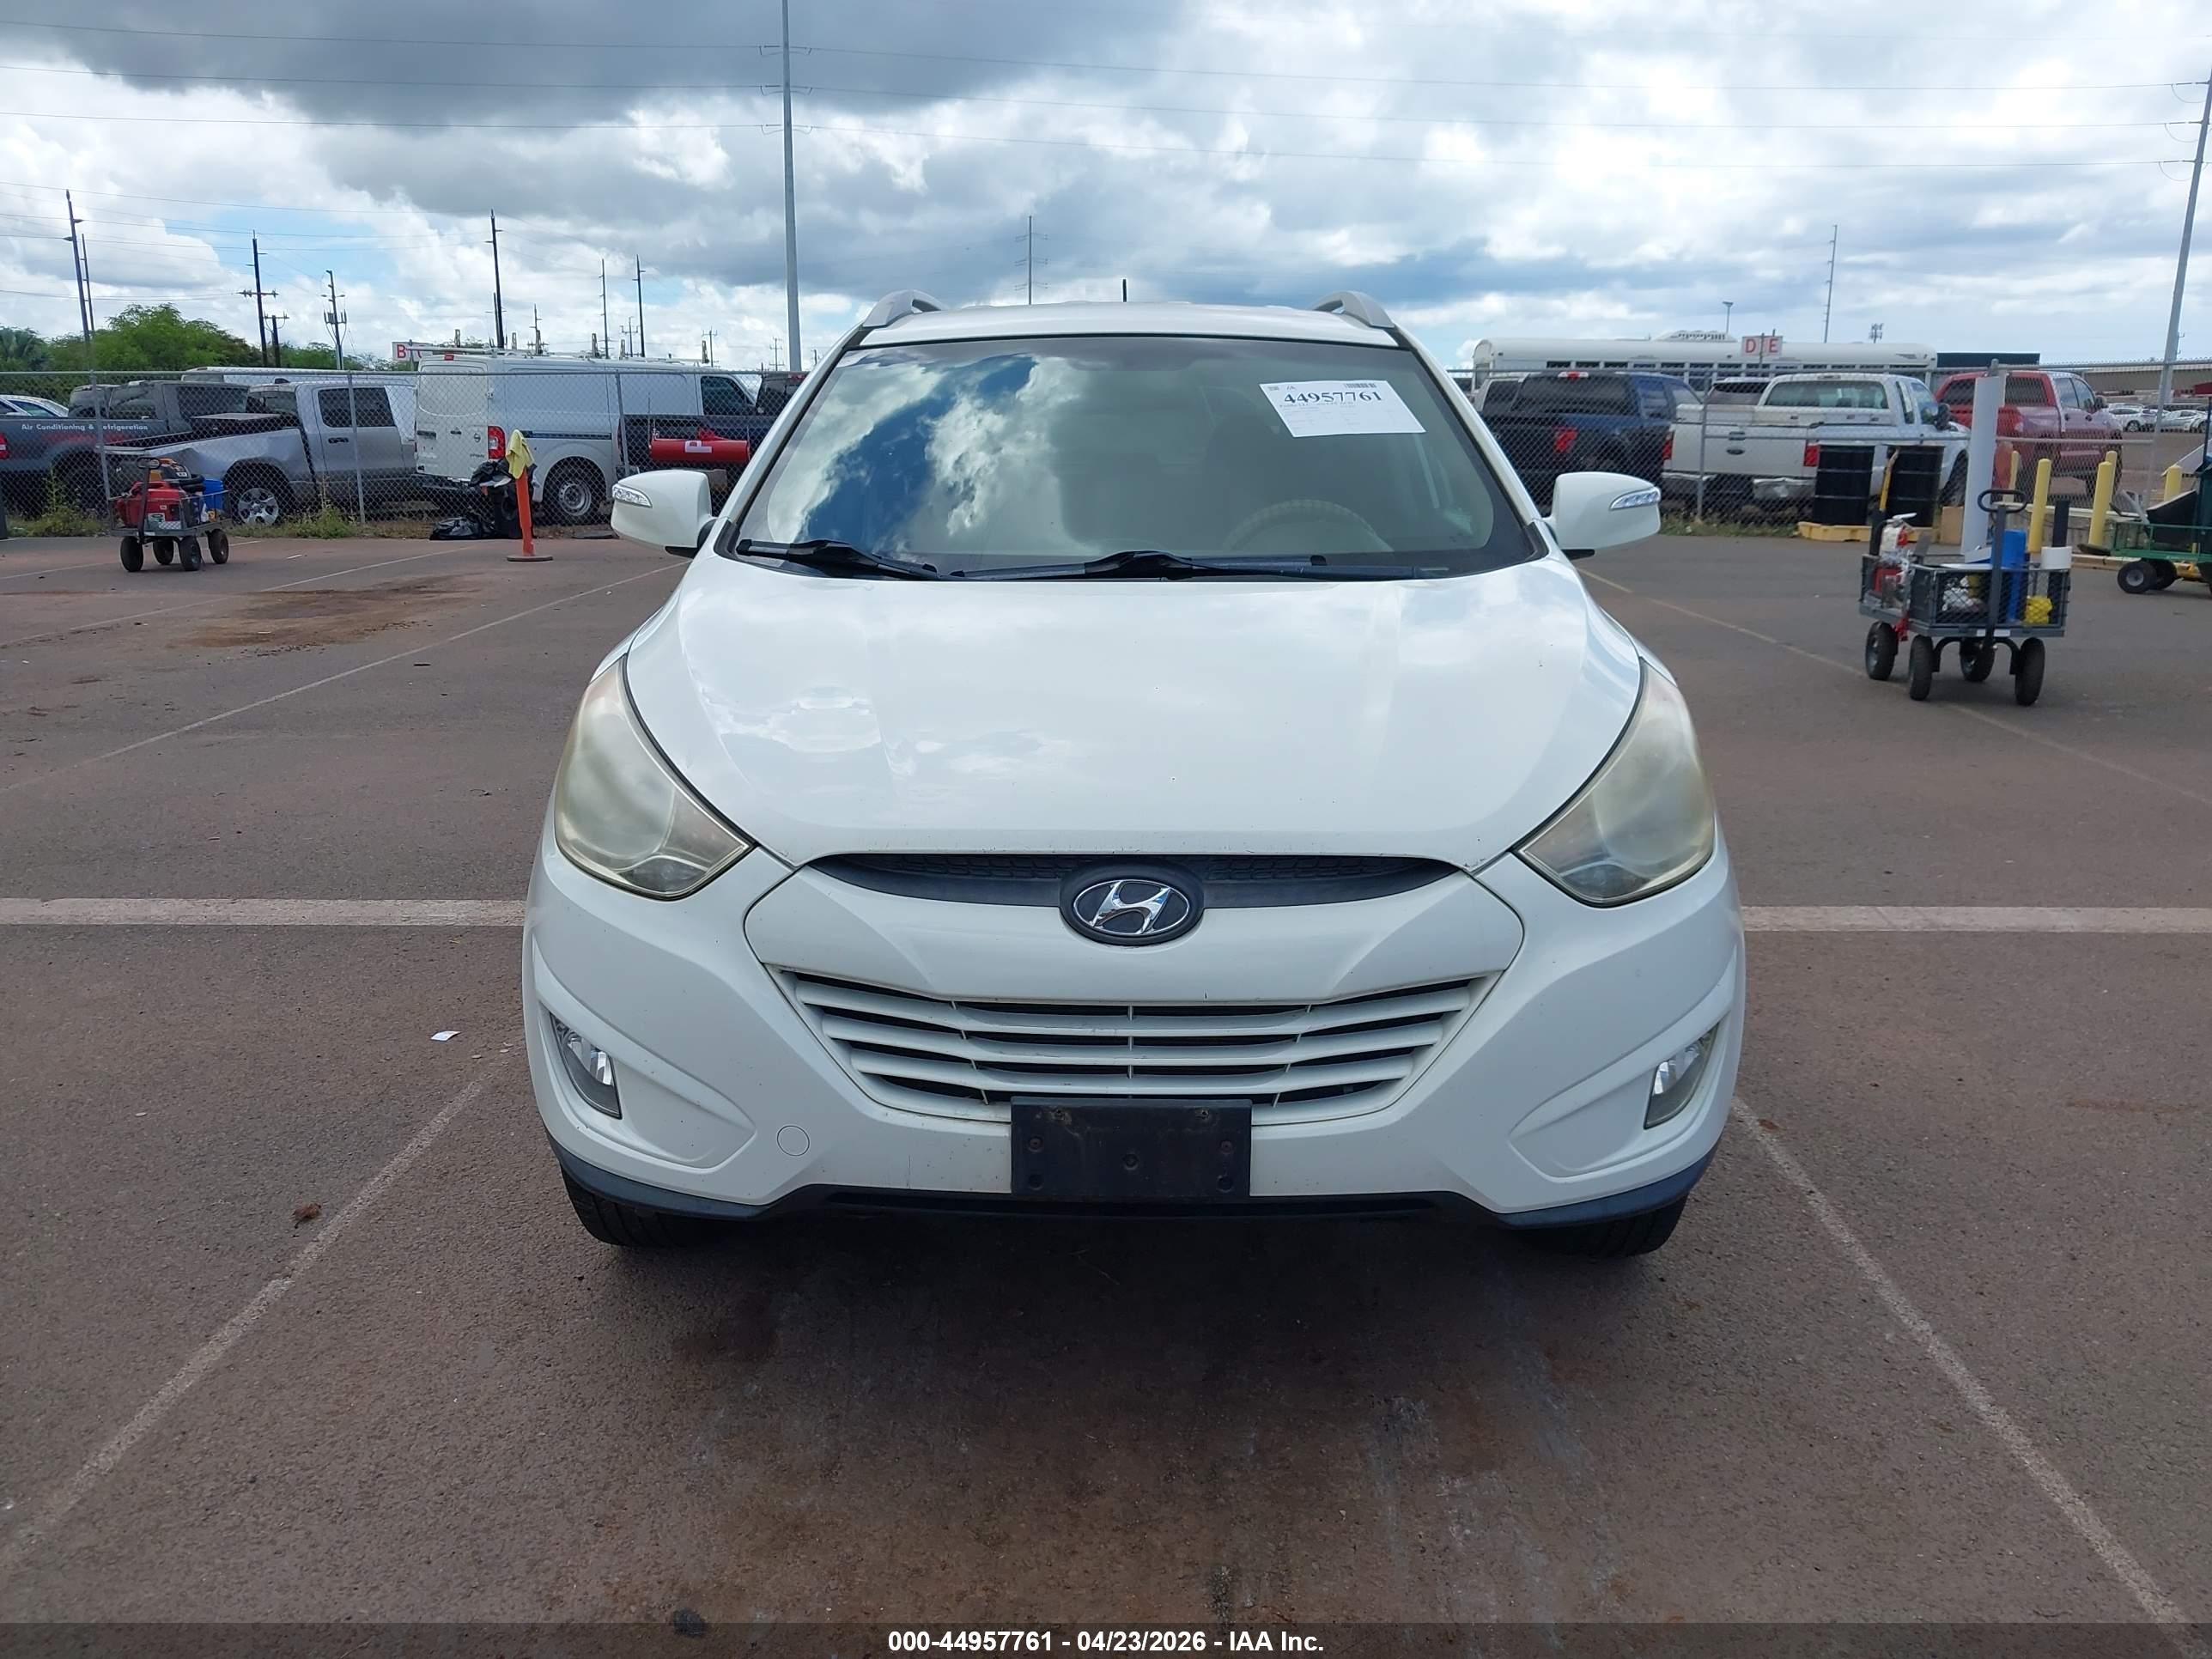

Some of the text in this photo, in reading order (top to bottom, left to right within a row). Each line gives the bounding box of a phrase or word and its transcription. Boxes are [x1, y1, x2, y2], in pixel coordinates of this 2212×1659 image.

[397, 344, 406, 358] B
[1747, 339, 1779, 353] D E
[1284, 391, 1382, 404] 44957761
